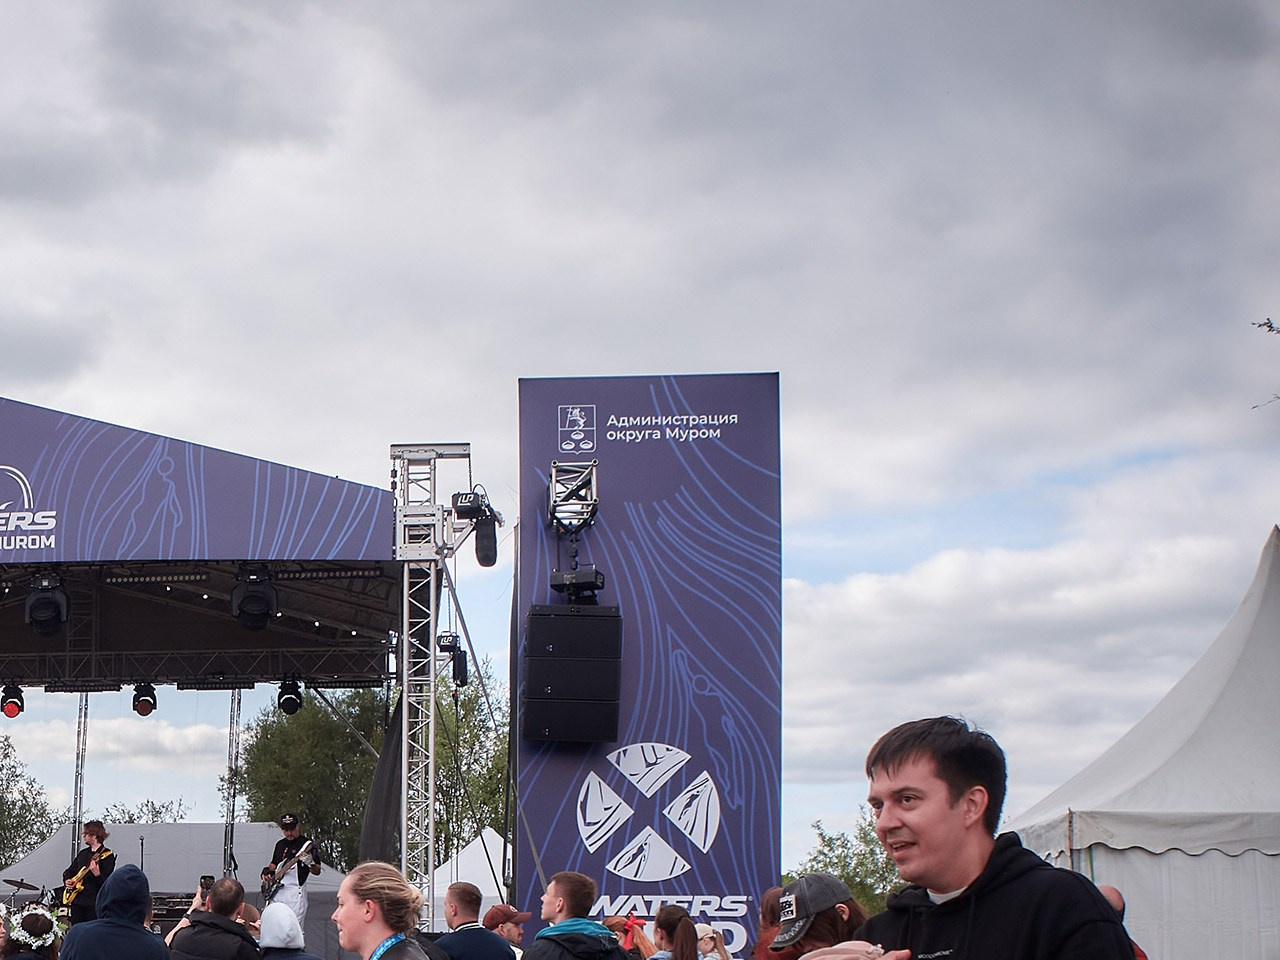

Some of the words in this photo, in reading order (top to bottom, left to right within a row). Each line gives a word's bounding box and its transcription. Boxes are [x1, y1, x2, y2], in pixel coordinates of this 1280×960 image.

[607, 414, 738, 427] Администрация
[606, 429, 661, 442] округа
[666, 427, 720, 441] Муром
